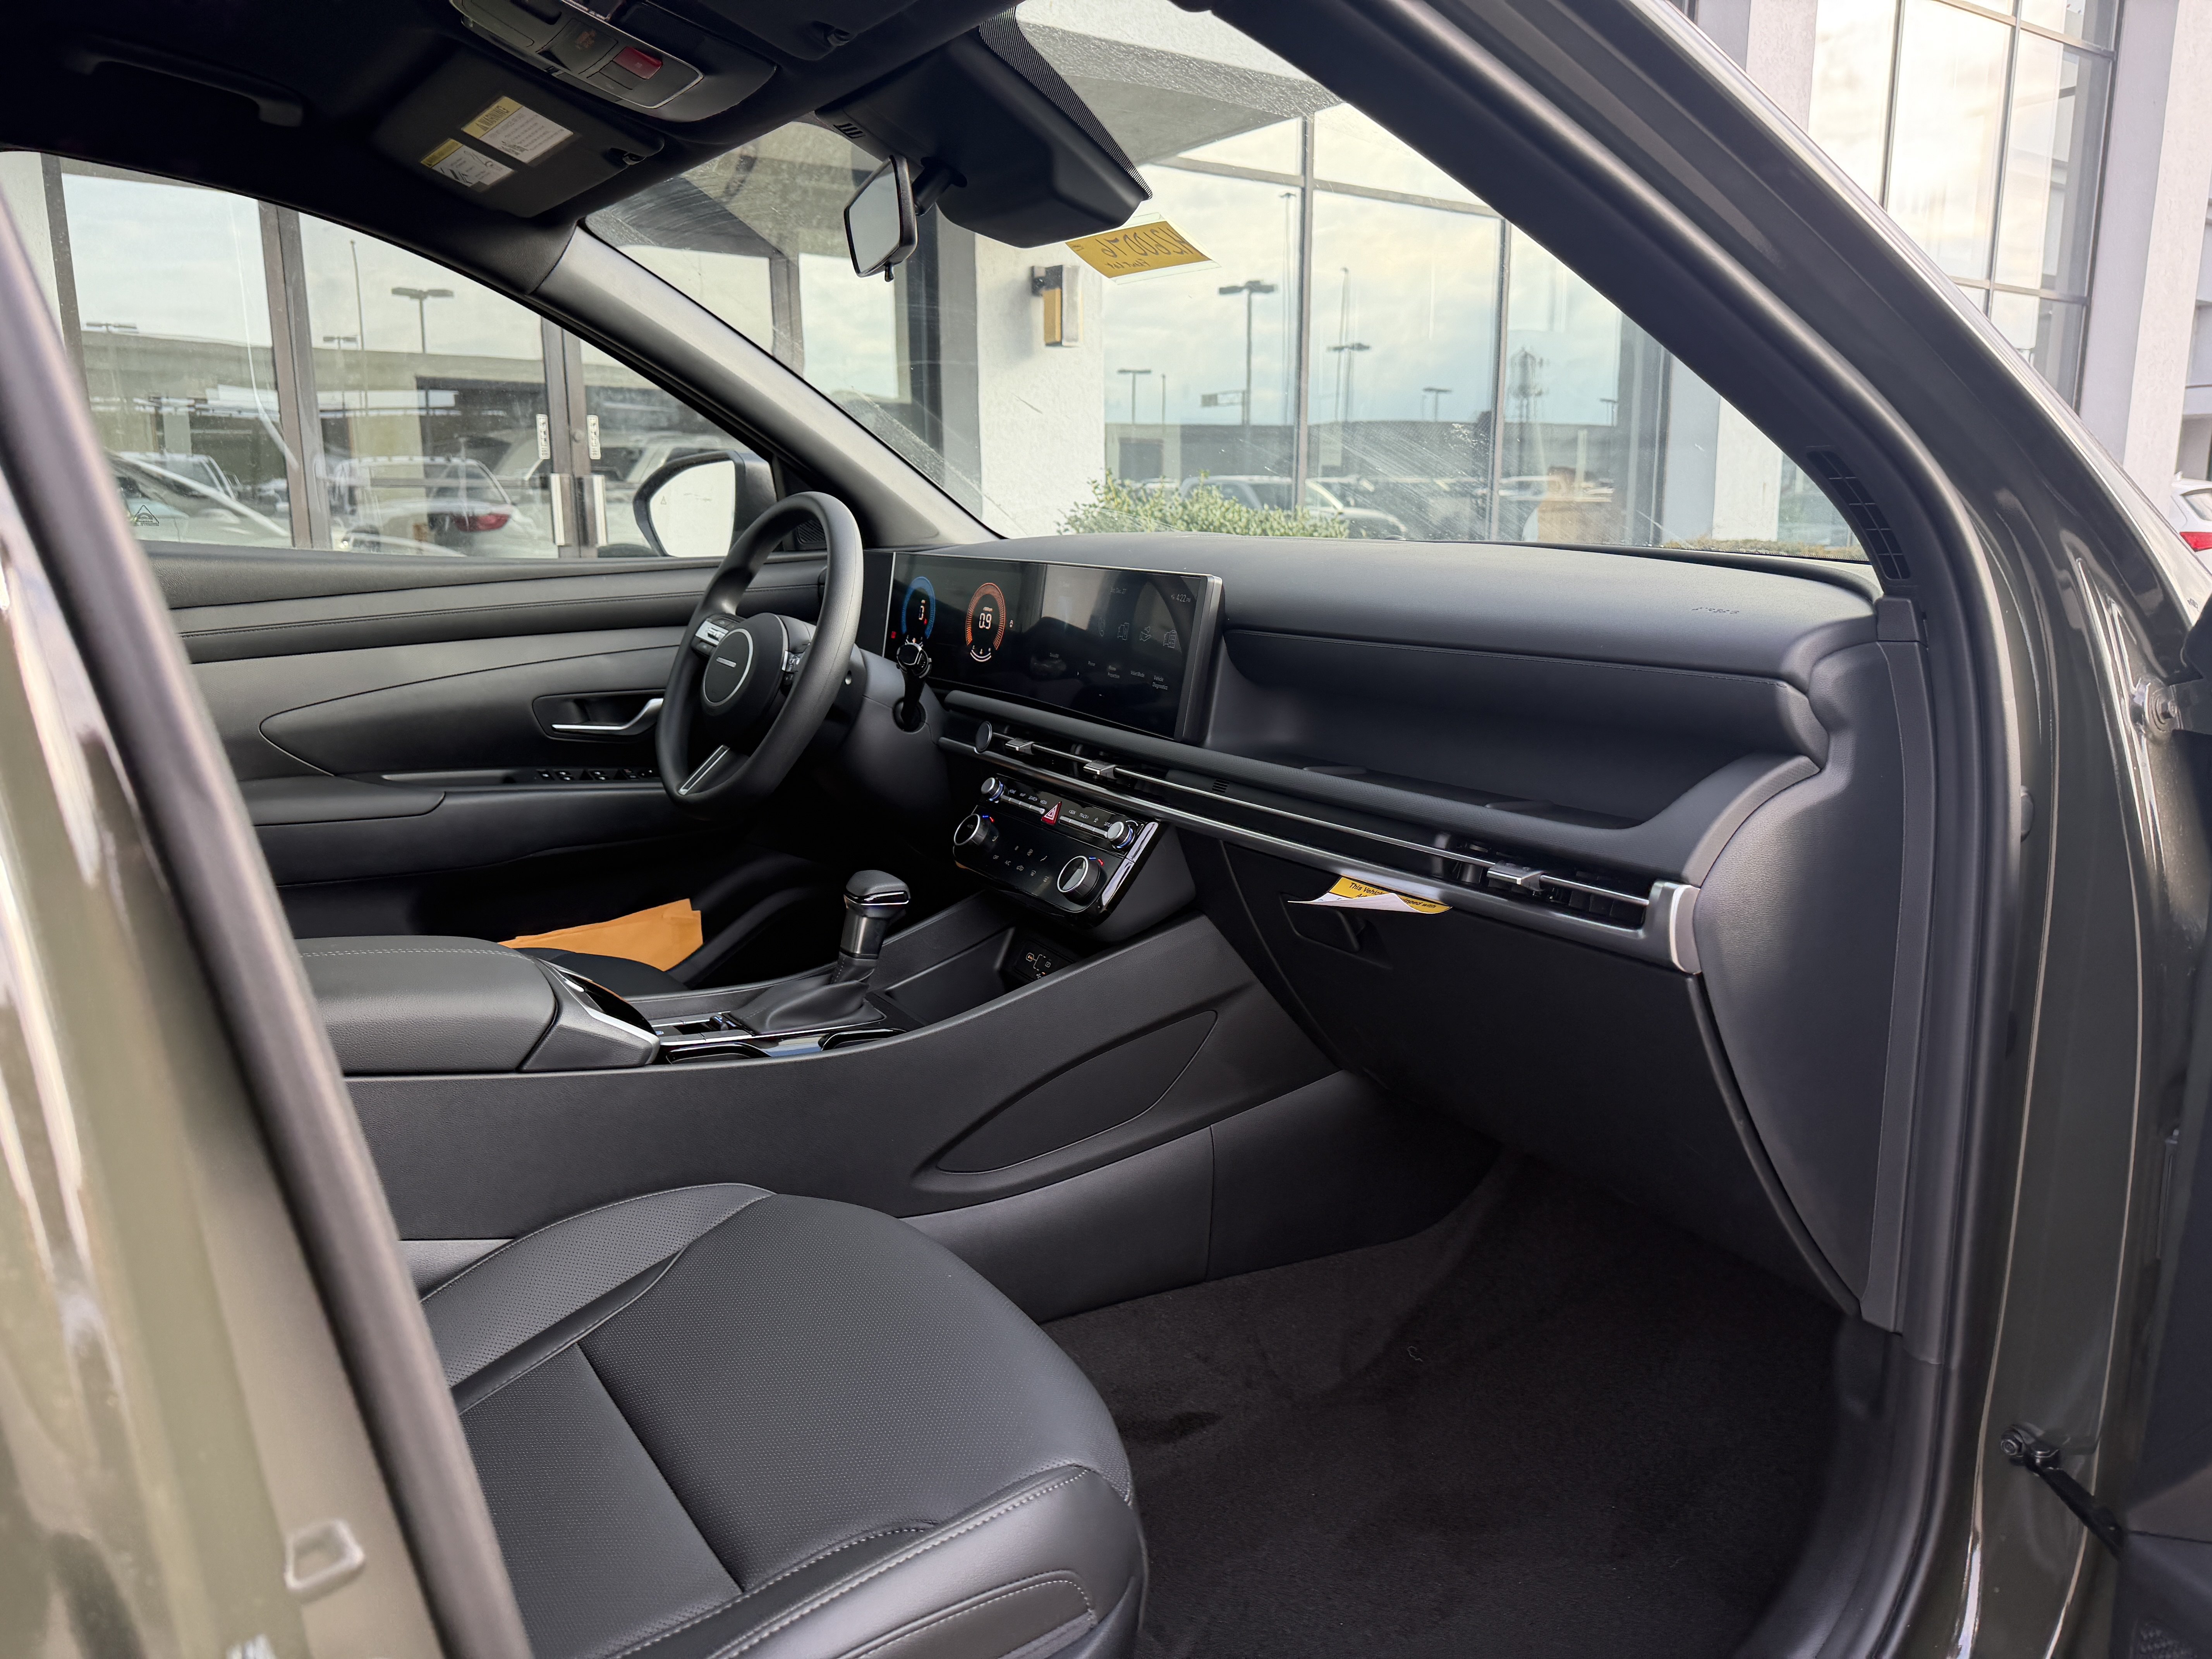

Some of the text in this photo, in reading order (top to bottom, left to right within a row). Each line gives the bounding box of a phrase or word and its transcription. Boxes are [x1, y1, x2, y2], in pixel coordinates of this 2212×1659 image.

[478, 105, 510, 127] WARNING
[1176, 594, 1186, 602] 4:22
[979, 612, 992, 629] 0.9
[1349, 882, 1362, 891] This
